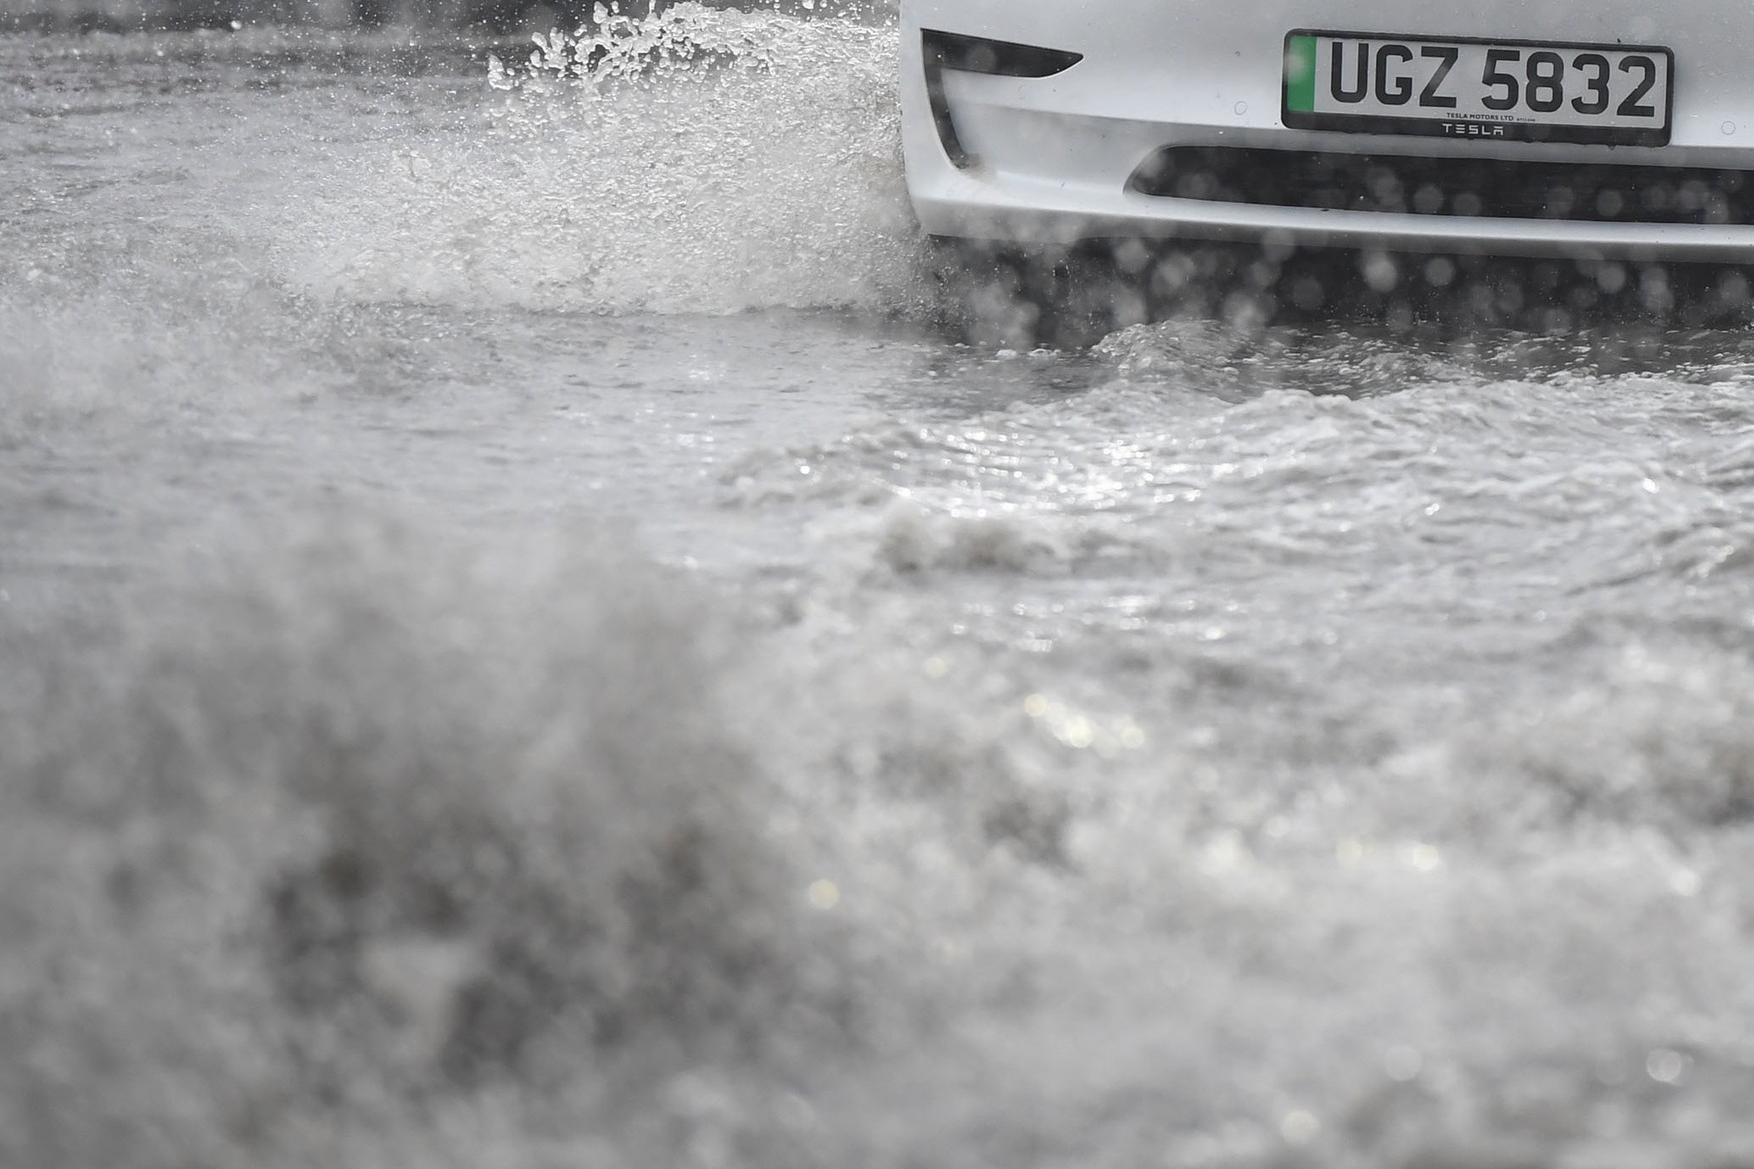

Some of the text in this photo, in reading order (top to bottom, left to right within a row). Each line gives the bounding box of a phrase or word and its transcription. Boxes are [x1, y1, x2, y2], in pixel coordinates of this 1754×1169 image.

[1331, 41, 1656, 118] UGZ 5832
[1469, 113, 1499, 121] MOTORS
[1442, 123, 1504, 136] TESLA
